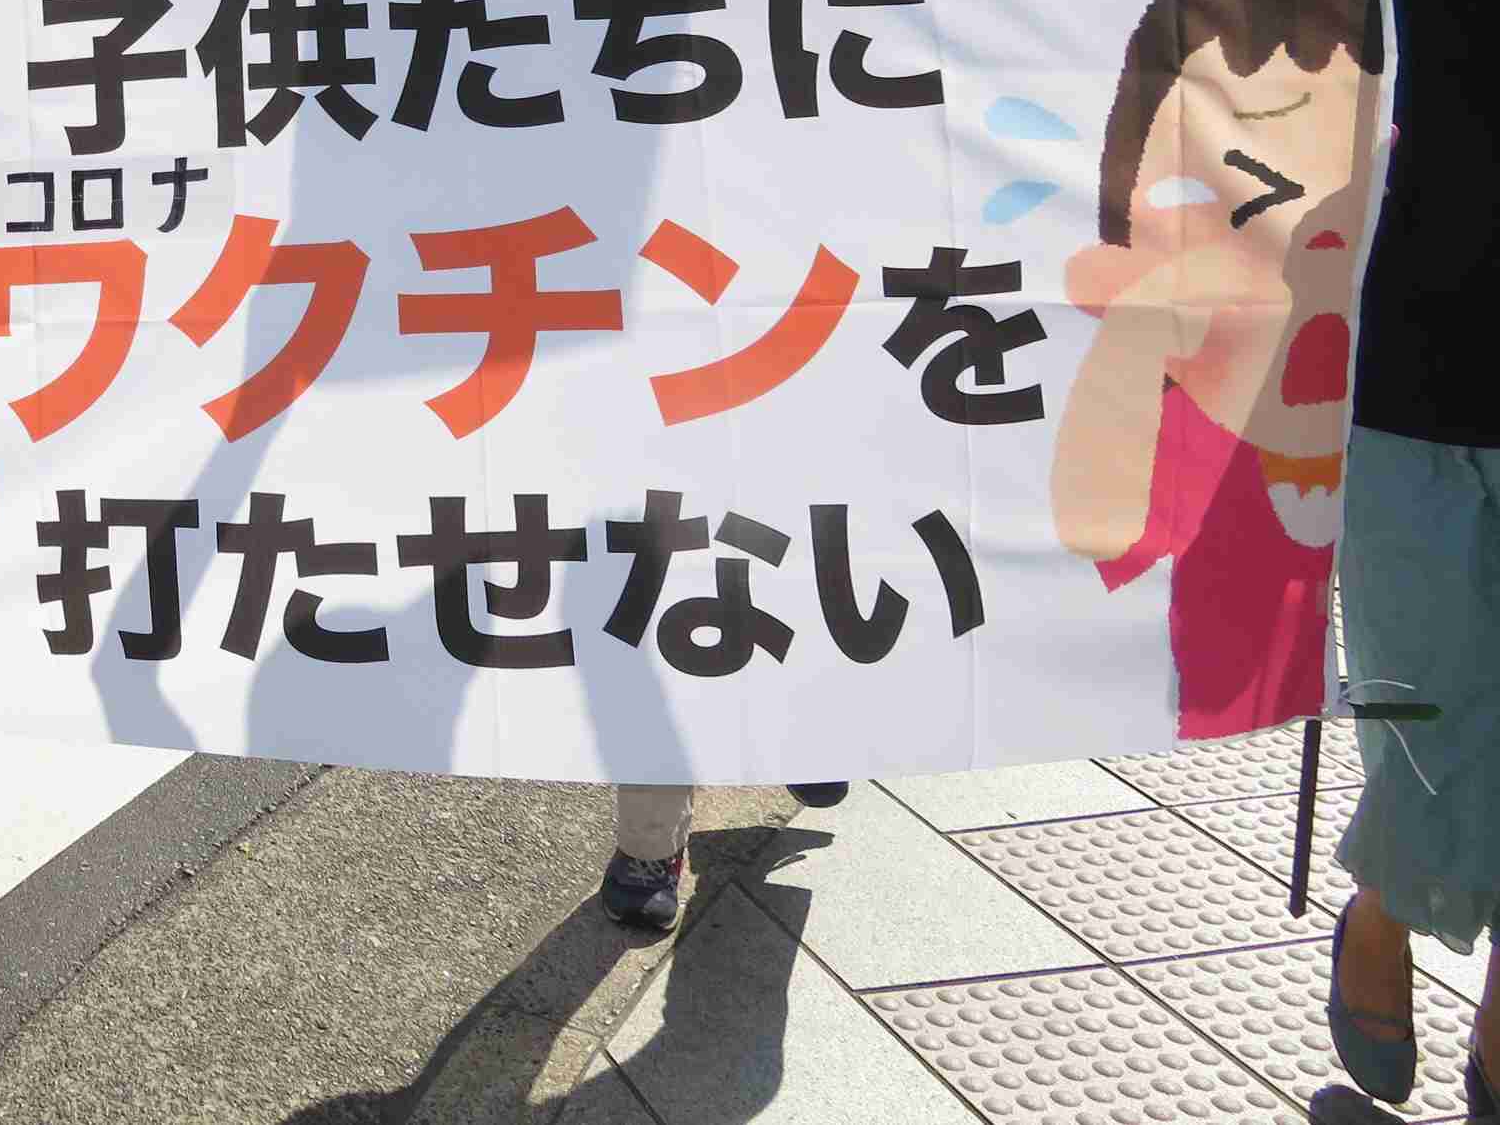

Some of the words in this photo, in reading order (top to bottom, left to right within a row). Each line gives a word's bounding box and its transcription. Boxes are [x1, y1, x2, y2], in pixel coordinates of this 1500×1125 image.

[6, 157, 209, 233] コロナ
[36, 488, 986, 678] 打たせない
